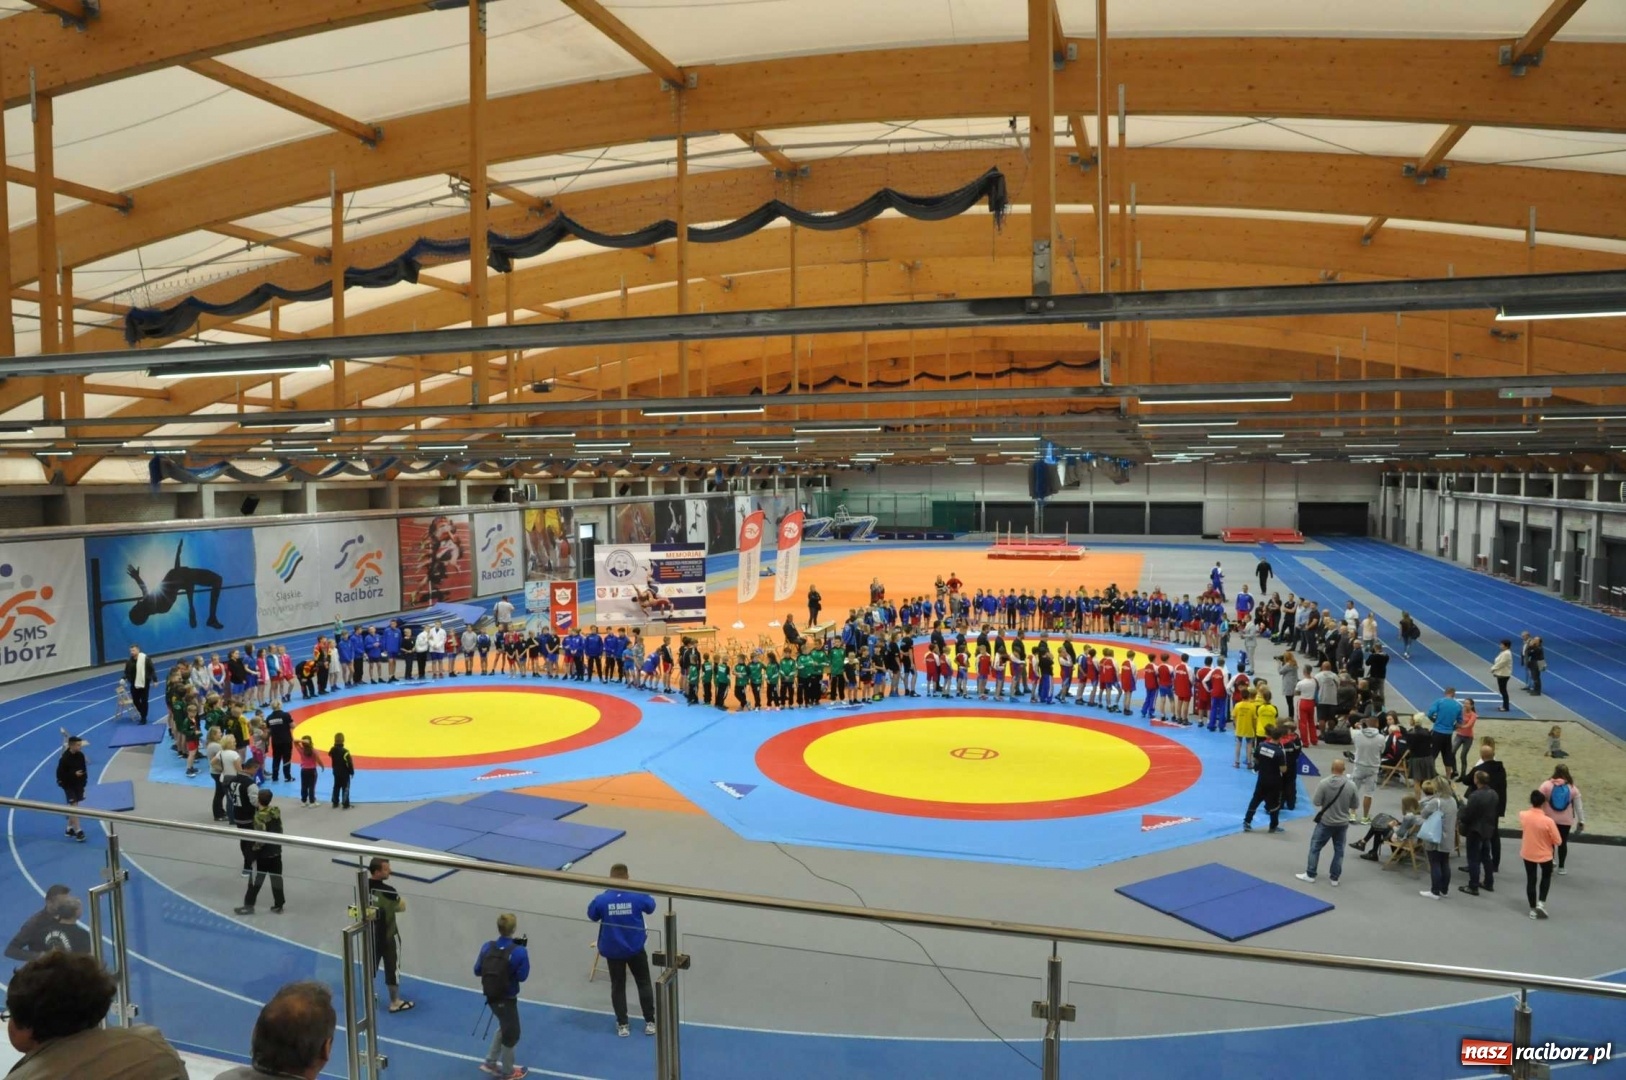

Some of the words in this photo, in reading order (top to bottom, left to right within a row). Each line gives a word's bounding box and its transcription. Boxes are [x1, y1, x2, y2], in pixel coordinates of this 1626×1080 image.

[363, 575, 380, 586] SMS
[335, 586, 384, 604] Racibórz
[13, 625, 48, 643] SMS
[1302, 764, 1310, 773] B
